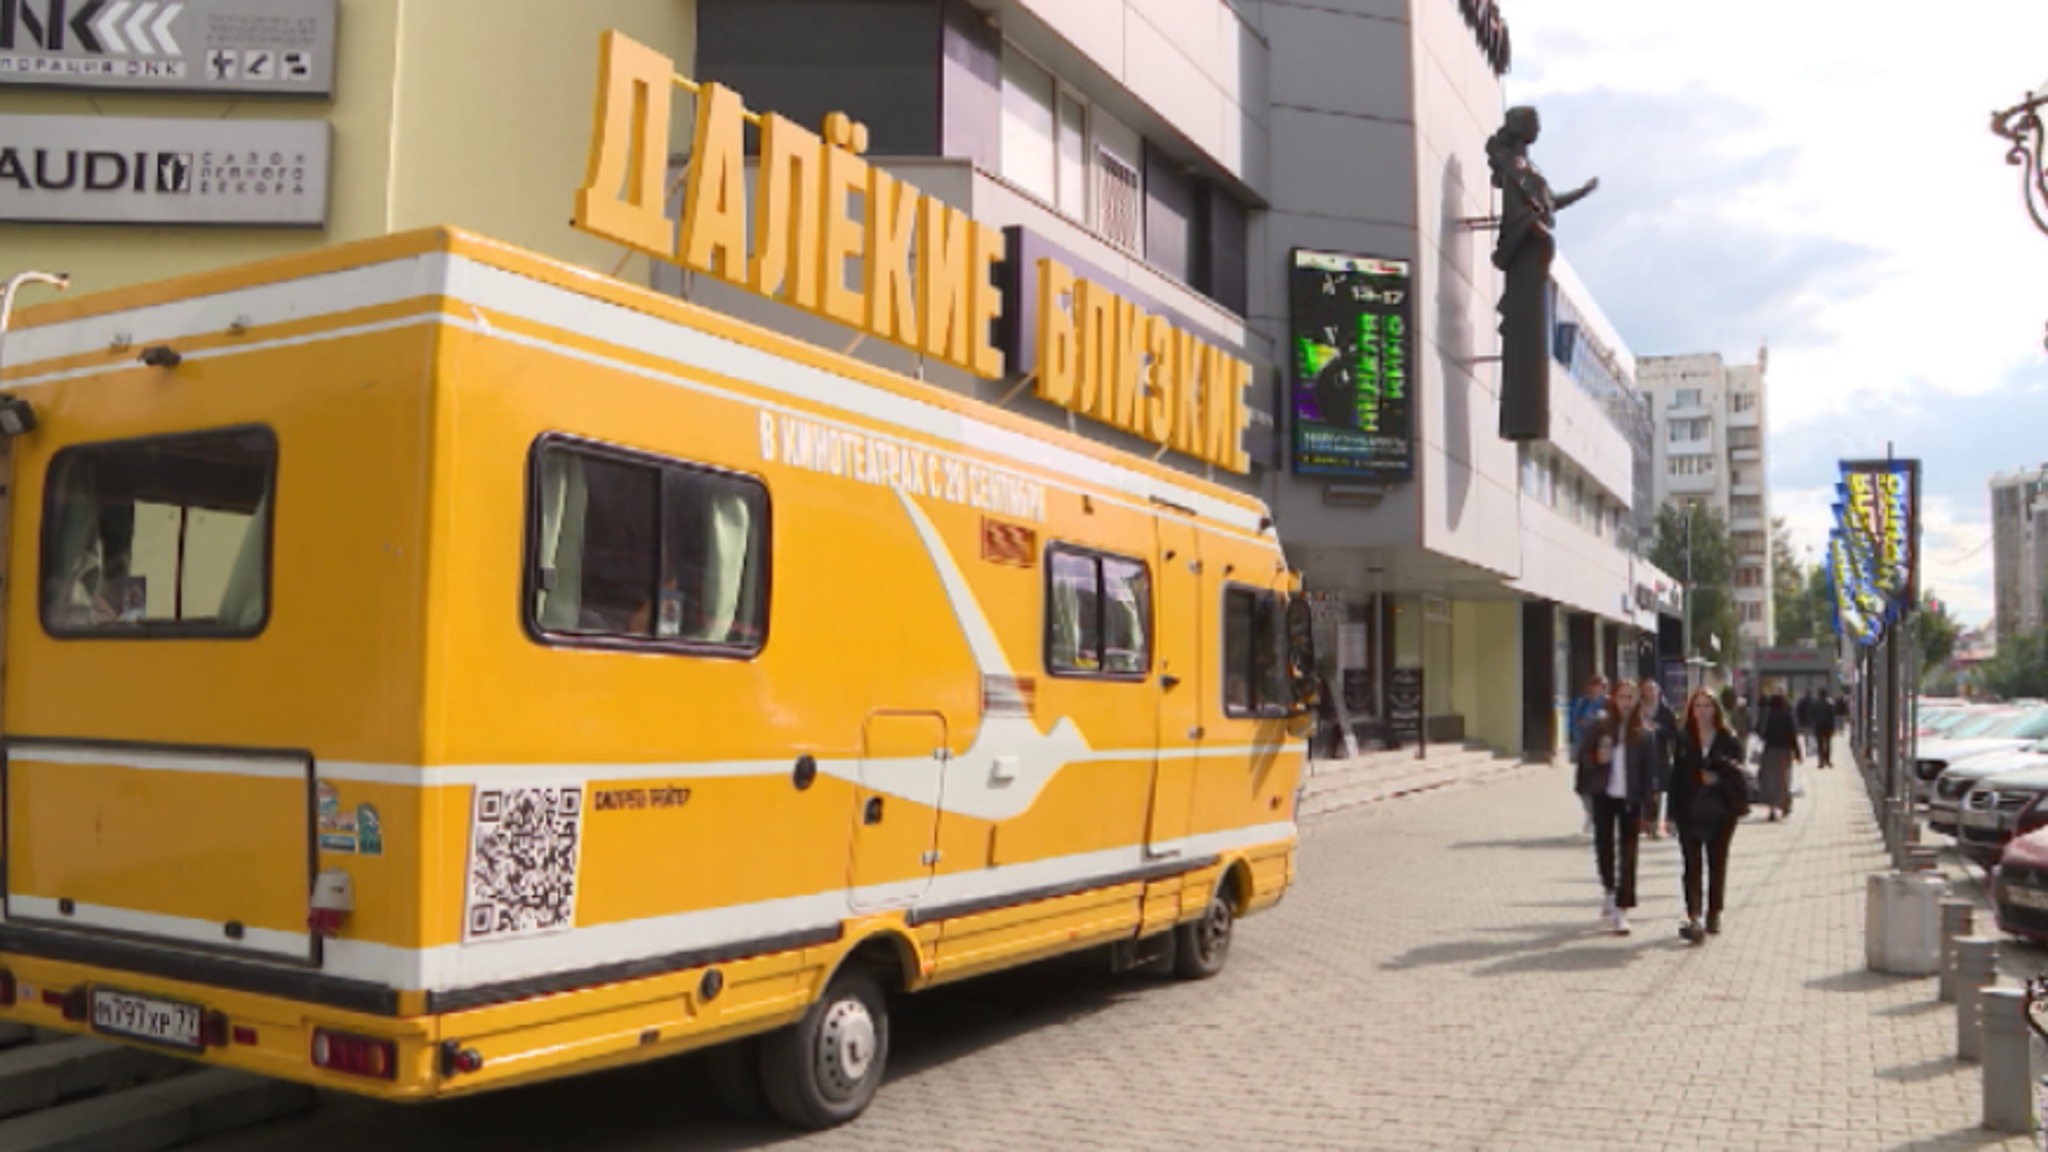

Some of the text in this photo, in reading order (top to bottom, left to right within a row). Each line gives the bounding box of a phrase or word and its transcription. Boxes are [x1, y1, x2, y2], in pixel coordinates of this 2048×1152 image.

[576, 28, 1006, 381] ДАЛЁКИЕ
[758, 409, 775, 461] В
[779, 415, 926, 496] КИНОТЕАТРАХ
[927, 453, 942, 499] С
[1032, 257, 1253, 475] БЛИЗКИЕ
